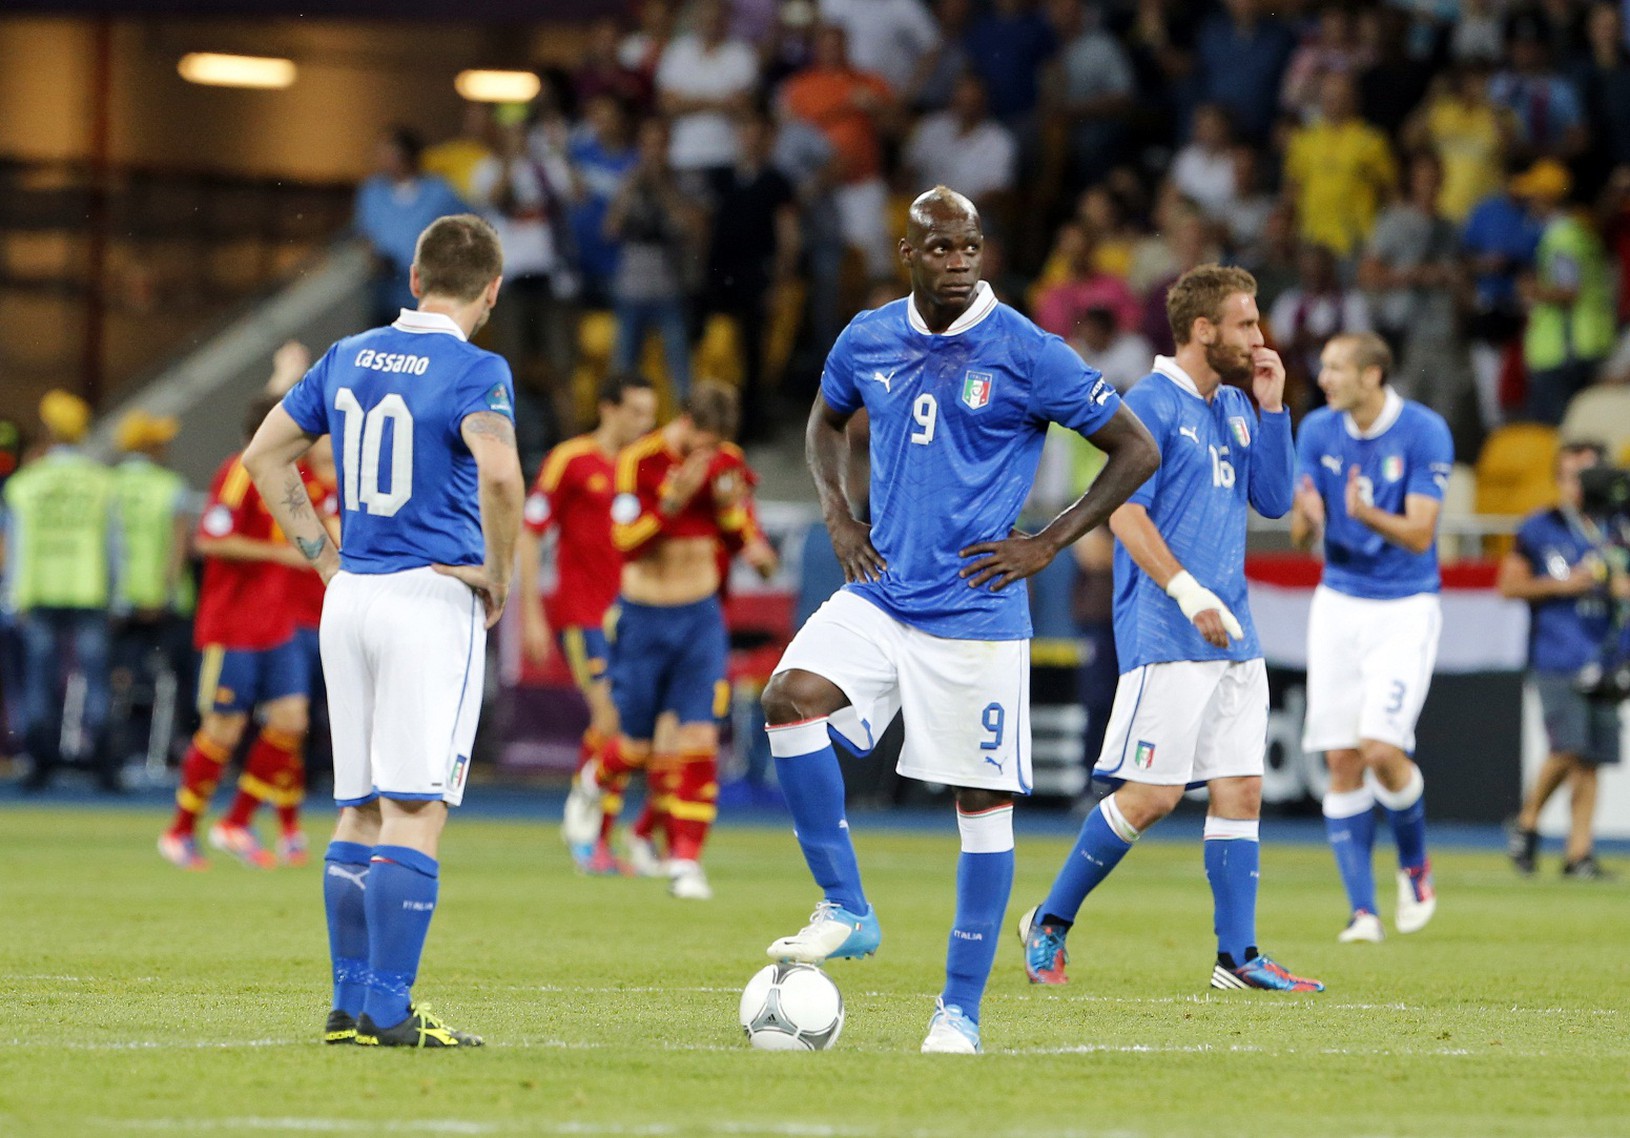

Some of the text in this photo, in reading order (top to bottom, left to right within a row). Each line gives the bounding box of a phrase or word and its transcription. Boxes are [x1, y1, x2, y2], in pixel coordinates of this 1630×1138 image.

[912, 393, 937, 445] 9
[334, 387, 413, 517] 10
[1208, 445, 1236, 488] 16
[1385, 680, 1406, 715] 3
[980, 702, 1005, 750] 9
[954, 929, 983, 941] ITALIA
